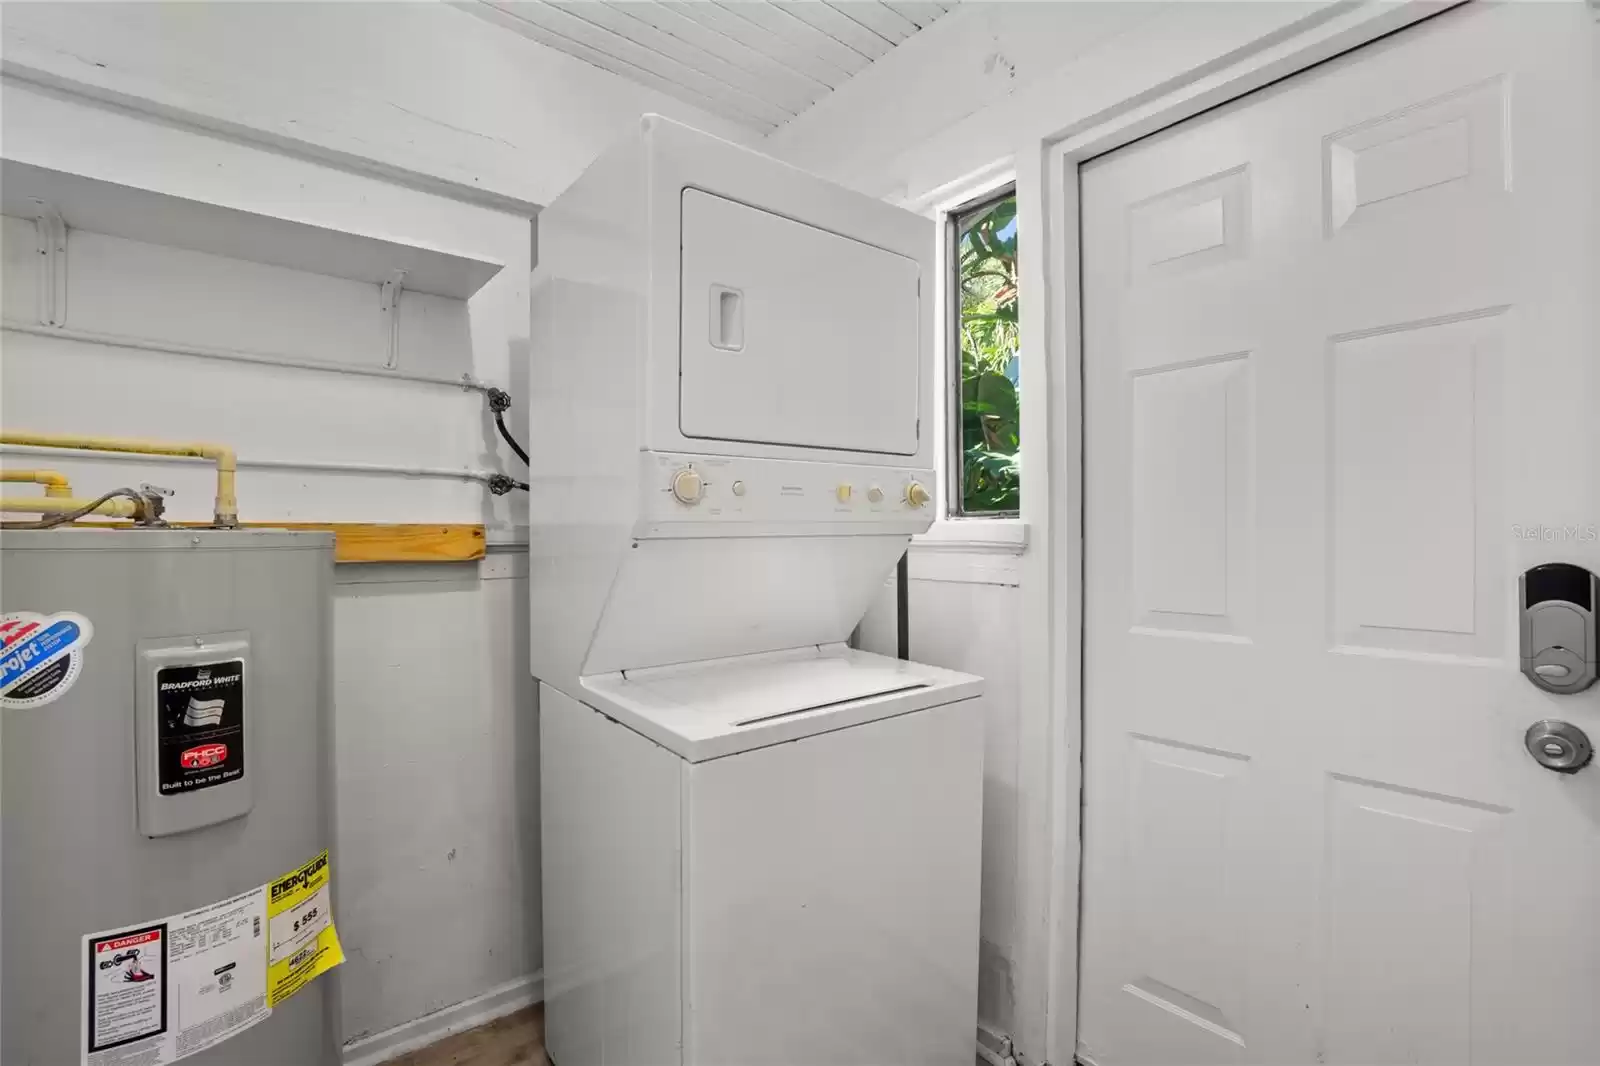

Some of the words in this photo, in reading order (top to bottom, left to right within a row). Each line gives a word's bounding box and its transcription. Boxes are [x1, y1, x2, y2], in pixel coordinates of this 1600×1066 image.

[0, 642, 41, 676] rojet
[161, 679, 212, 691] BRADFORD
[213, 674, 241, 685] WHITE
[184, 746, 225, 761] PHCC
[162, 780, 182, 791] Built
[195, 776, 207, 785] be
[209, 773, 222, 782] the
[223, 769, 241, 779] Best
[293, 920, 300, 932] $
[302, 907, 318, 926] 555
[113, 934, 152, 948] DANGER
